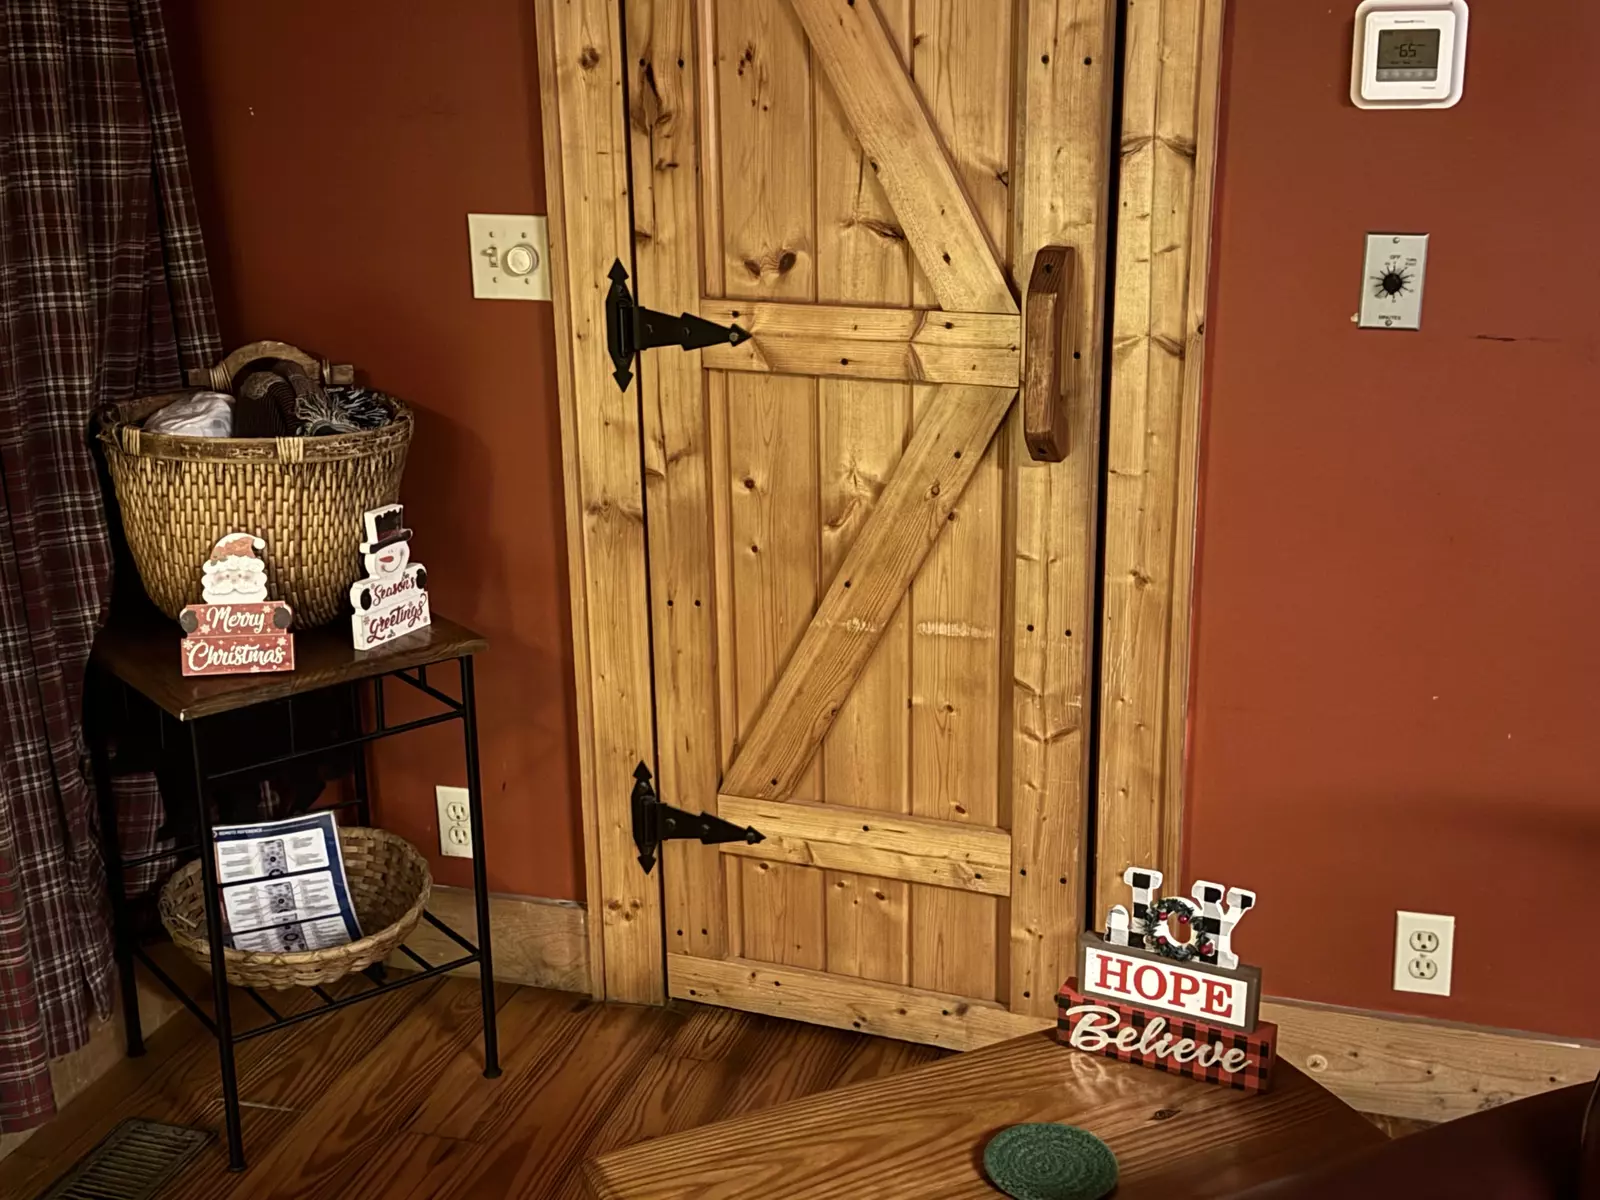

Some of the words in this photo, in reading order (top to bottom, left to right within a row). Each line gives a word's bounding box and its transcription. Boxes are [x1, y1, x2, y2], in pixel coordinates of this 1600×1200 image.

[205, 605, 265, 634] Merry
[366, 593, 427, 643] Greetings
[188, 641, 286, 671] Christmas
[1103, 866, 1256, 970] JOY
[1094, 953, 1233, 1019] HOPE
[1065, 1005, 1252, 1074] Believe
